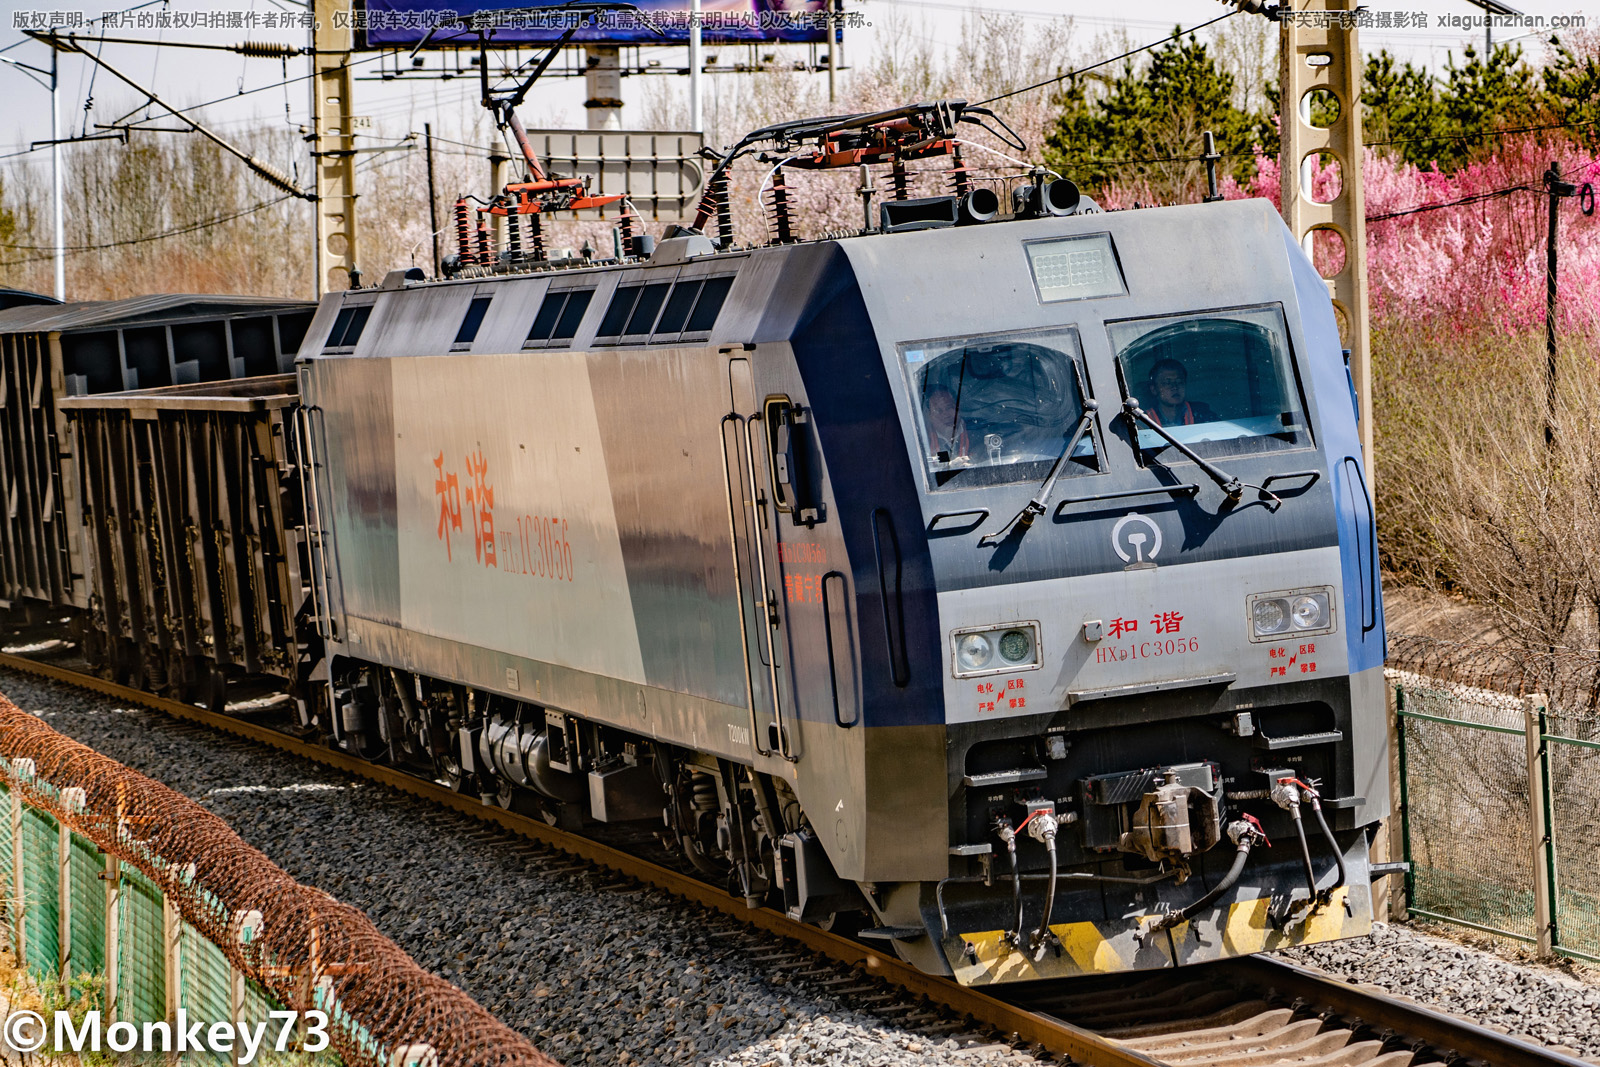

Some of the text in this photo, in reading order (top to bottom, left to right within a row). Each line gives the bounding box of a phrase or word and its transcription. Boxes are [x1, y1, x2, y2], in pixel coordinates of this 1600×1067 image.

[353, 117, 371, 128] 241
[433, 450, 497, 568] 和谐
[1096, 637, 1200, 664] HXD1C3056
[1269, 643, 1316, 659] 电化 区段
[1270, 662, 1317, 678] 严禁 攀登
[976, 678, 1025, 694] 电化 区段
[978, 697, 1026, 712] 严禁 攀登
